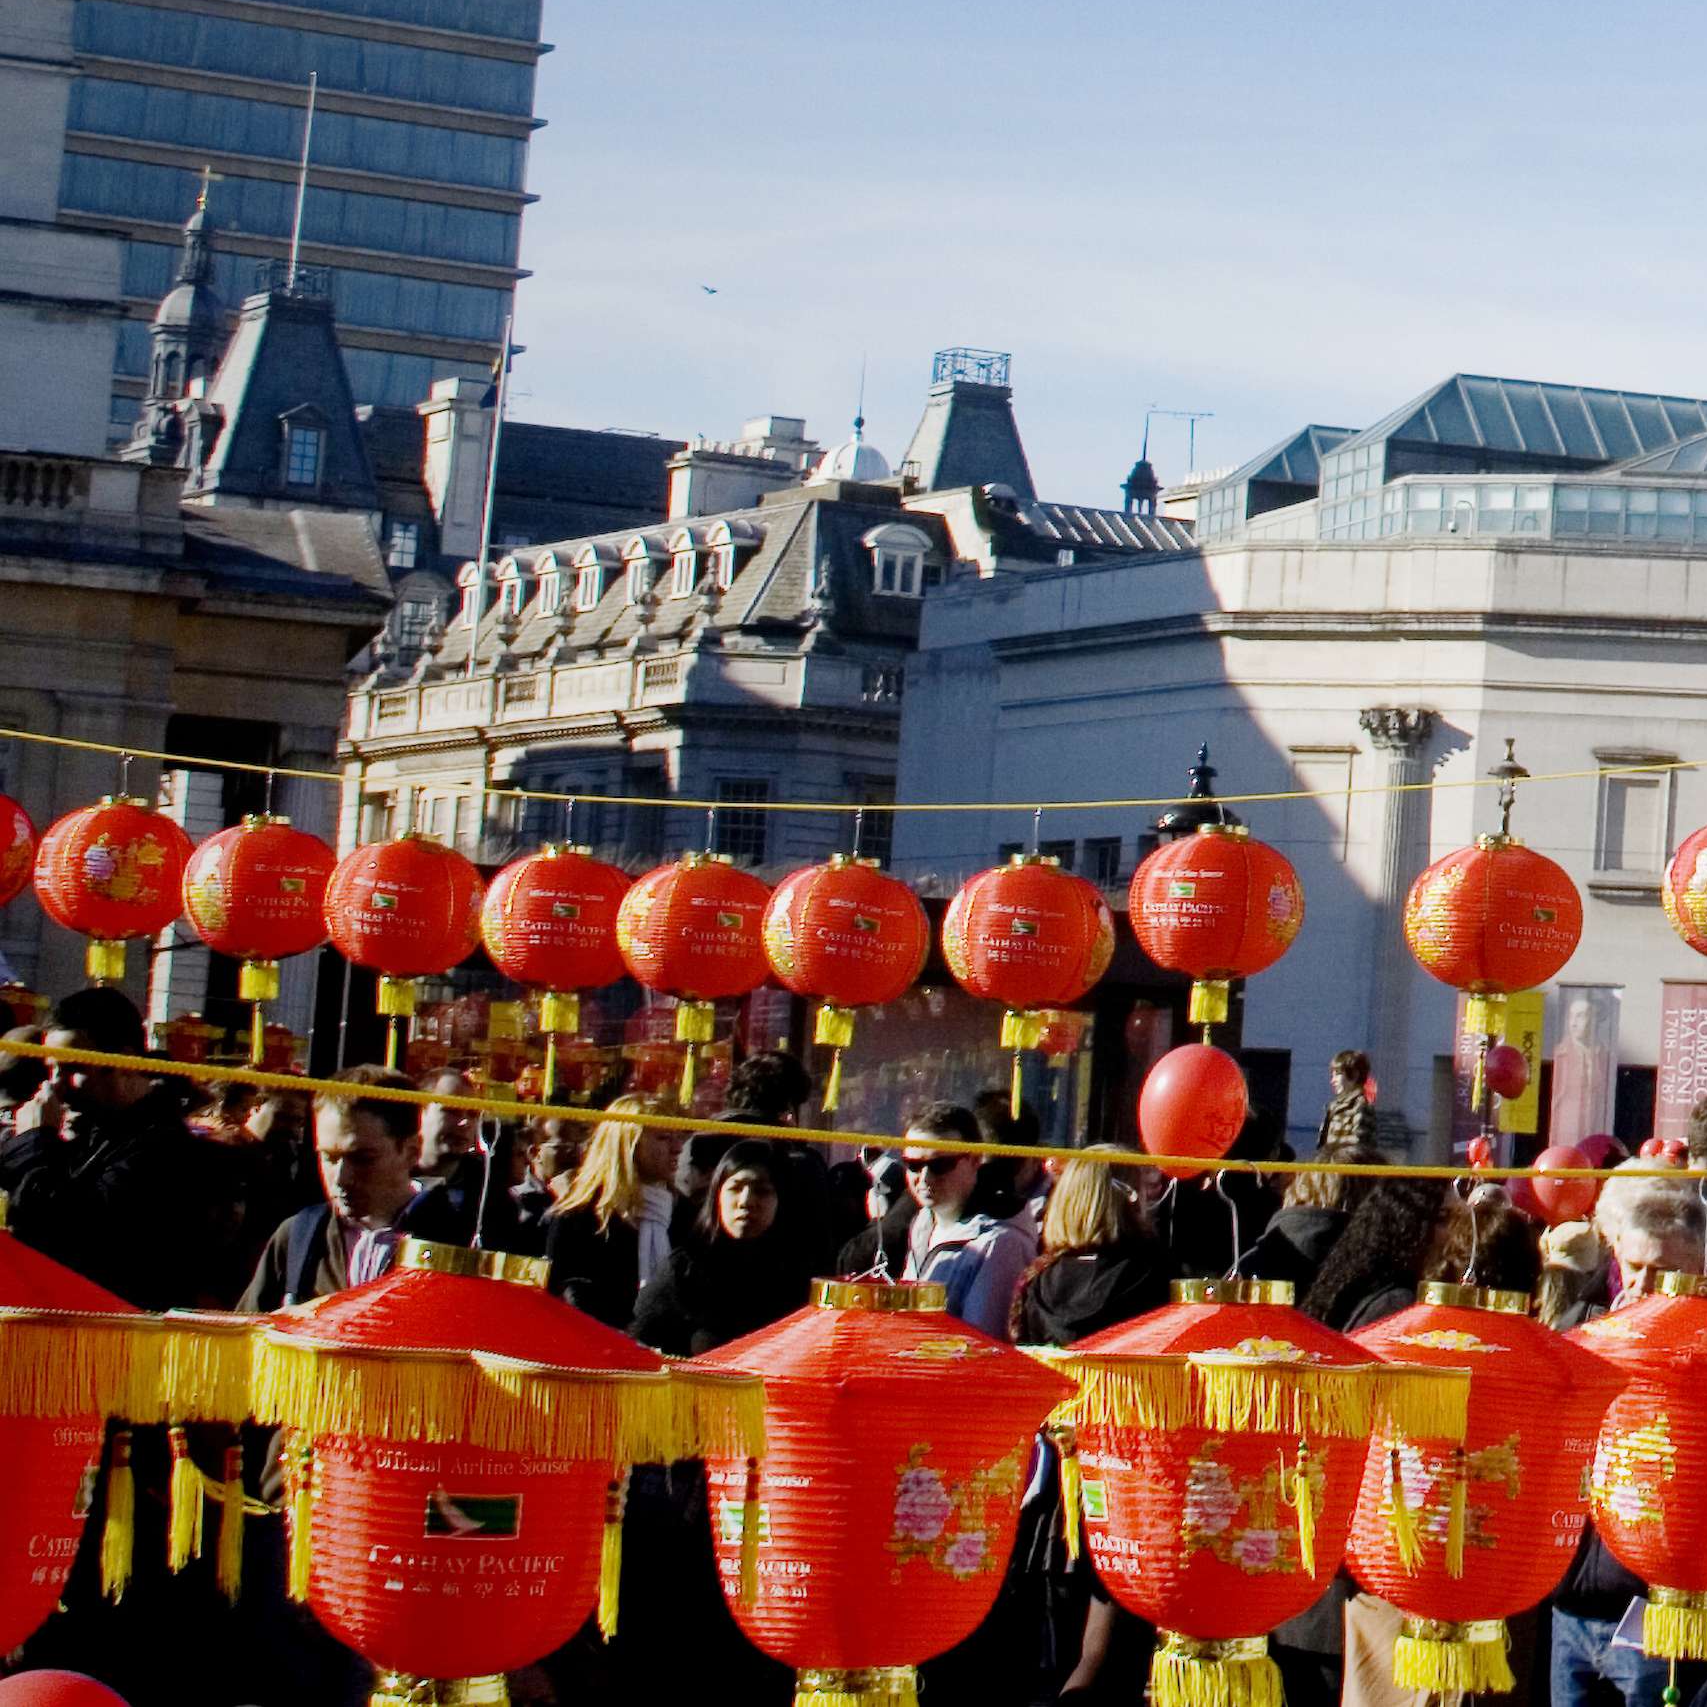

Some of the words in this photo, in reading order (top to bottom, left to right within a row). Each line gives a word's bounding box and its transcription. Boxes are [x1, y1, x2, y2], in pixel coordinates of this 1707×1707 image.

[1677, 1008, 1698, 1104] BATONI
[375, 1448, 442, 1474] Official
[450, 1455, 514, 1476] Airline
[519, 1457, 574, 1477] Sponsor
[368, 1544, 471, 1575] CATHAY
[479, 1553, 565, 1575] PACIFIC
